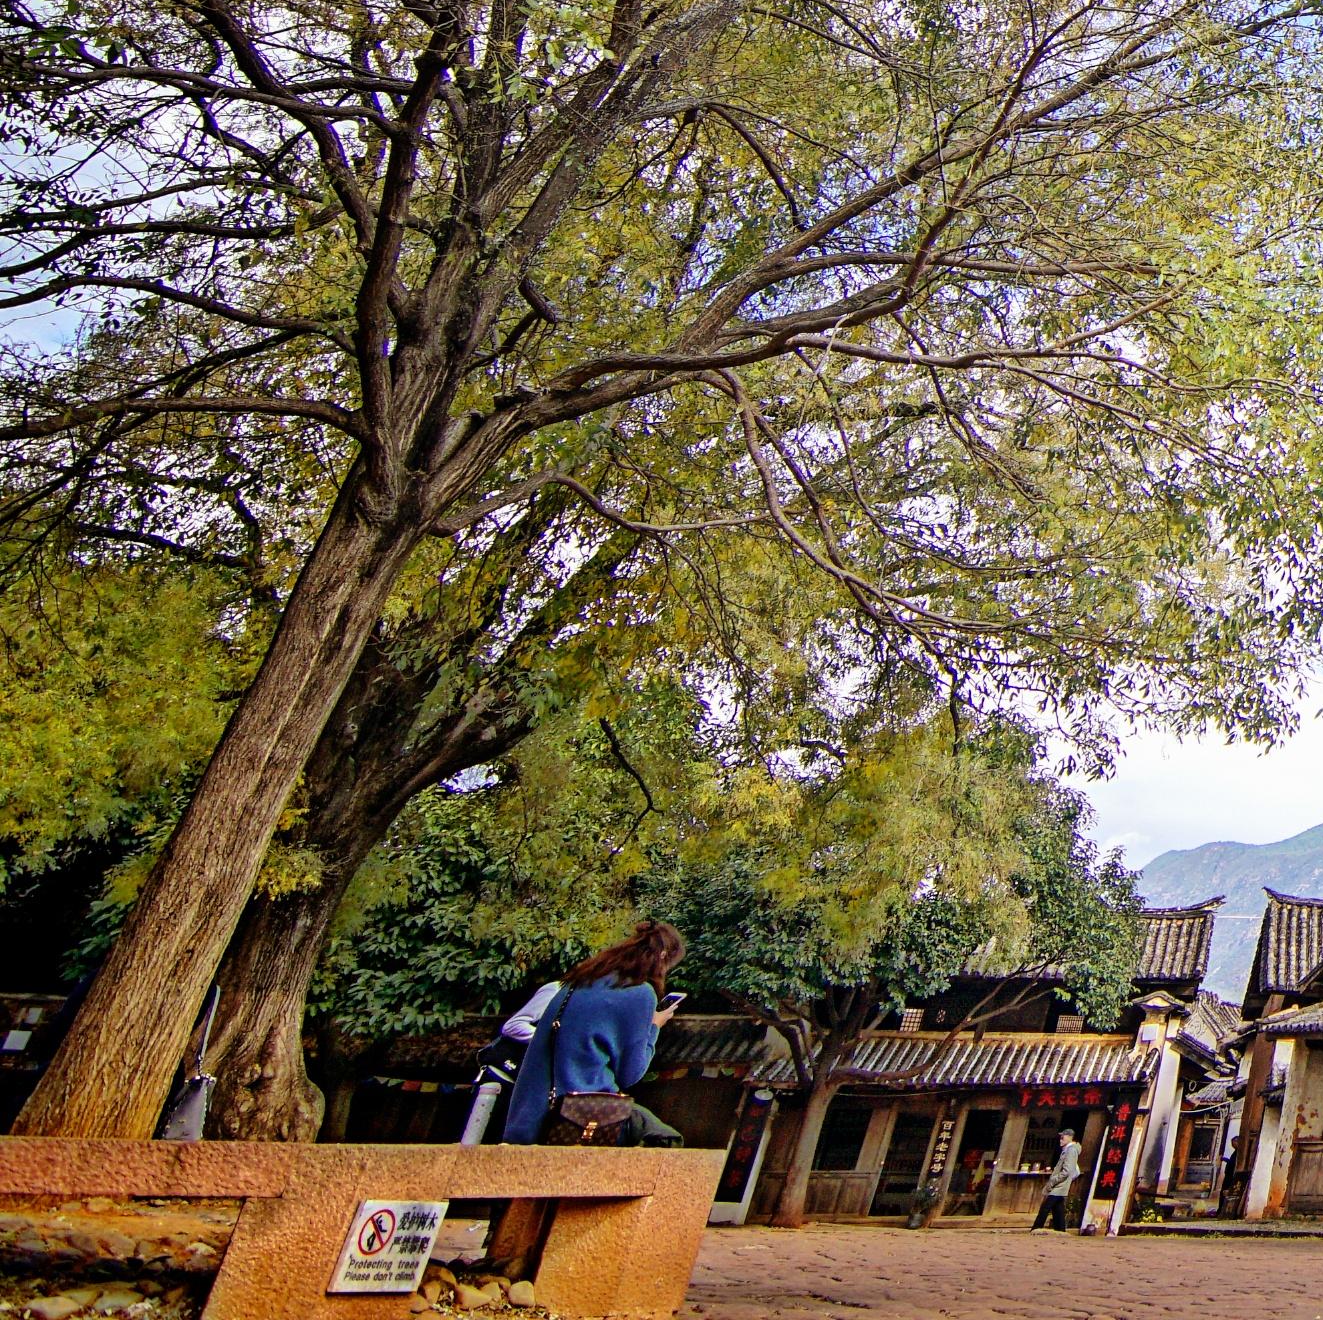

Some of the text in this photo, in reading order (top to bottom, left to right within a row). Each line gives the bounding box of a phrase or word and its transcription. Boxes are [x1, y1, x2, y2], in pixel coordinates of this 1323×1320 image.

[930, 1121, 955, 1173] 百年老字号
[349, 1260, 393, 1270] Protecting
[343, 1271, 371, 1281] Please
[373, 1271, 393, 1281] don't
